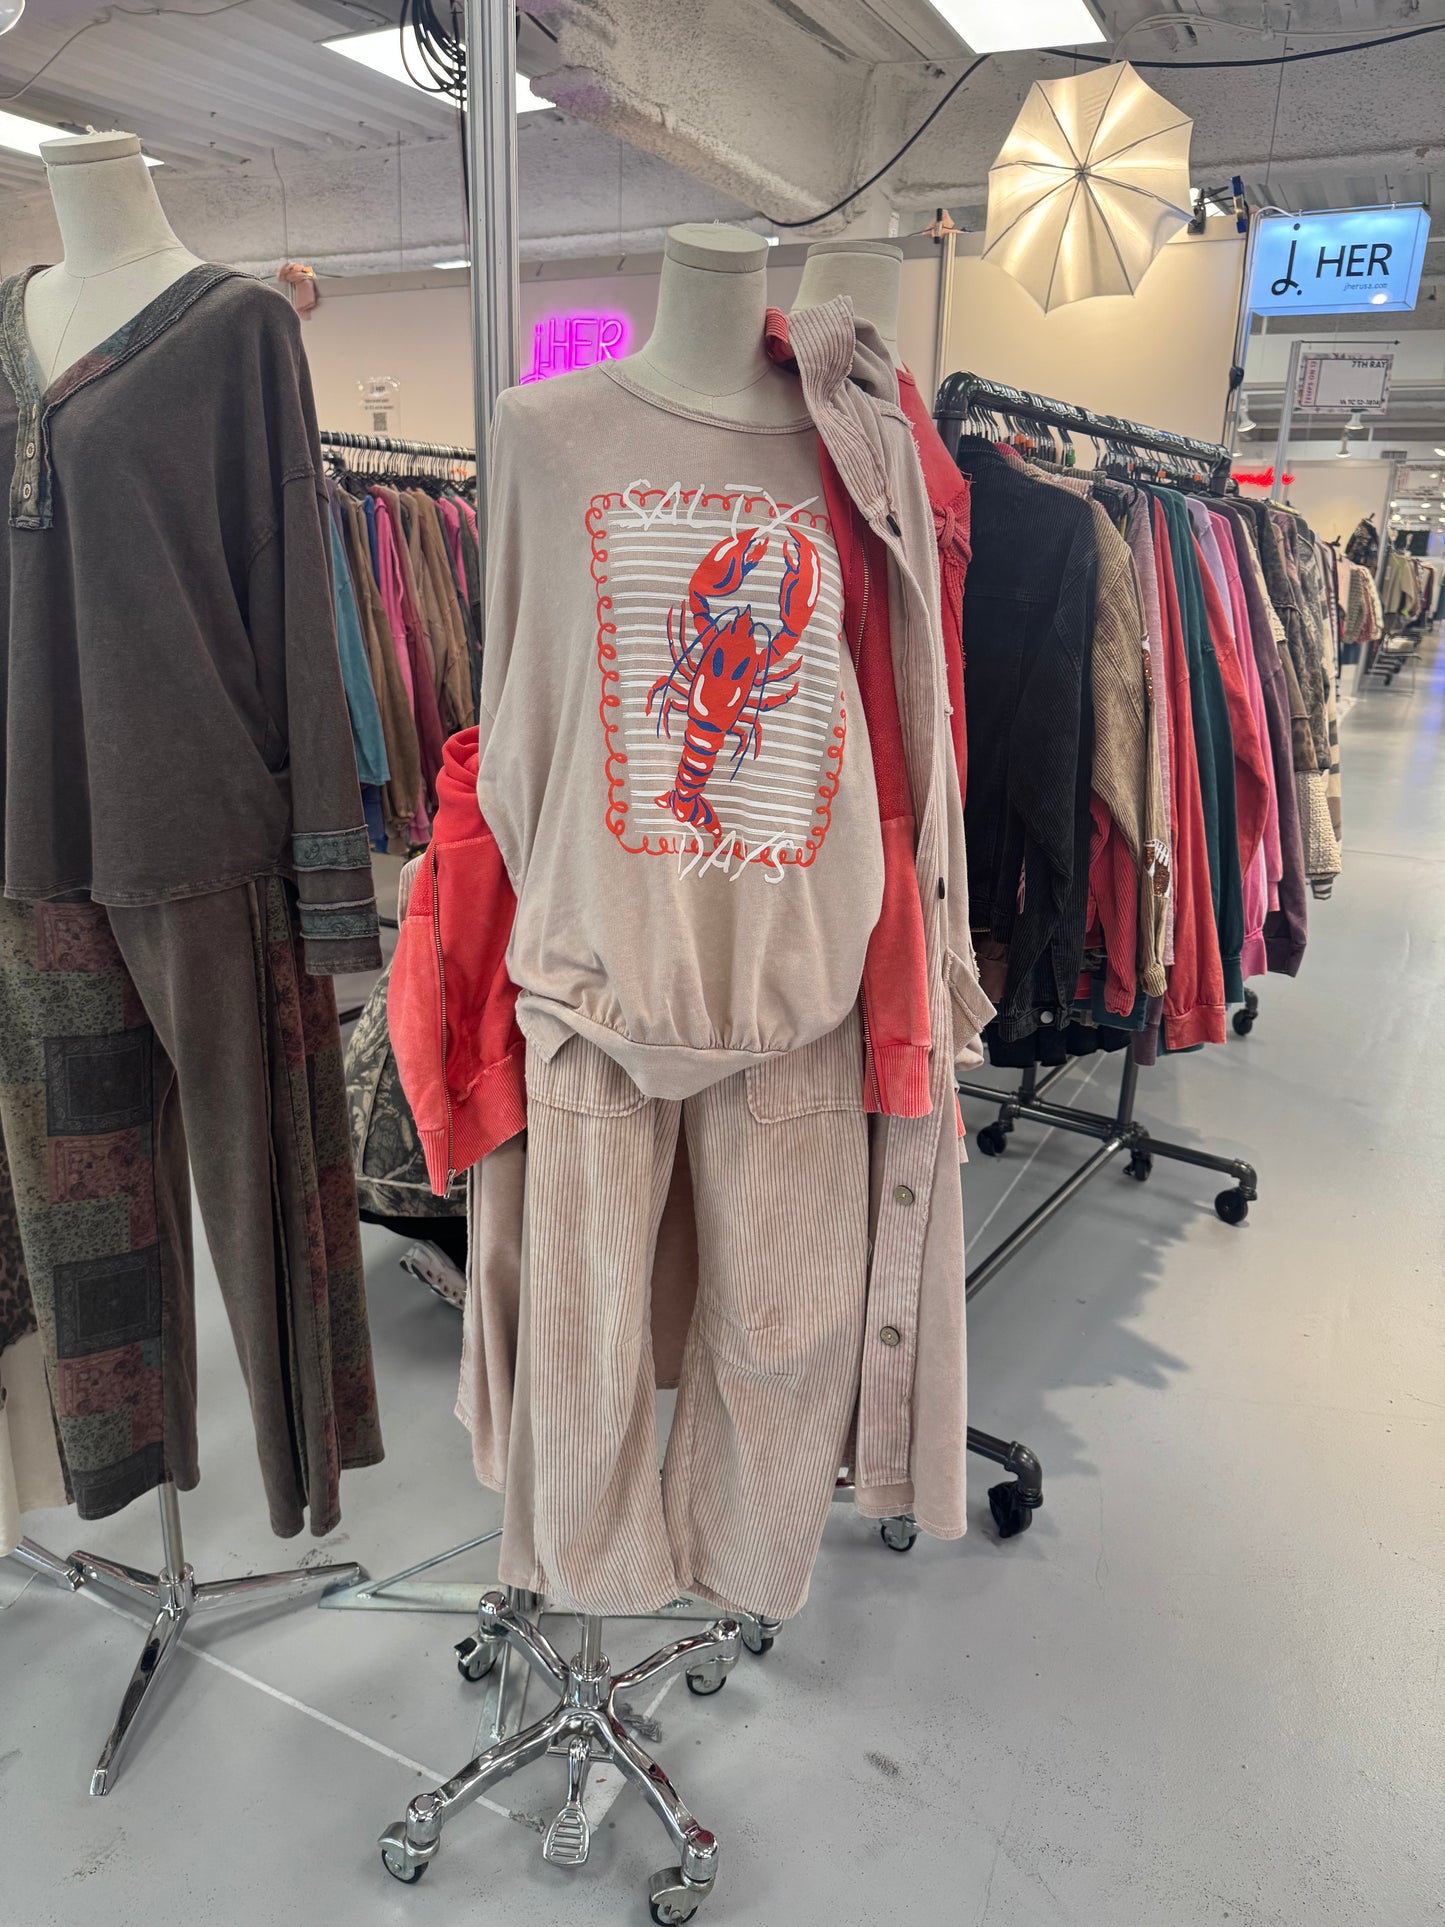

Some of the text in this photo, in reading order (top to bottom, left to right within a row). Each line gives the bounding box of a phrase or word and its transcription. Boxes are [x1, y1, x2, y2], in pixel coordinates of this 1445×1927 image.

[1316, 243, 1393, 278] HER
[623, 479, 819, 541] SALTY
[678, 822, 794, 884] DAYS
